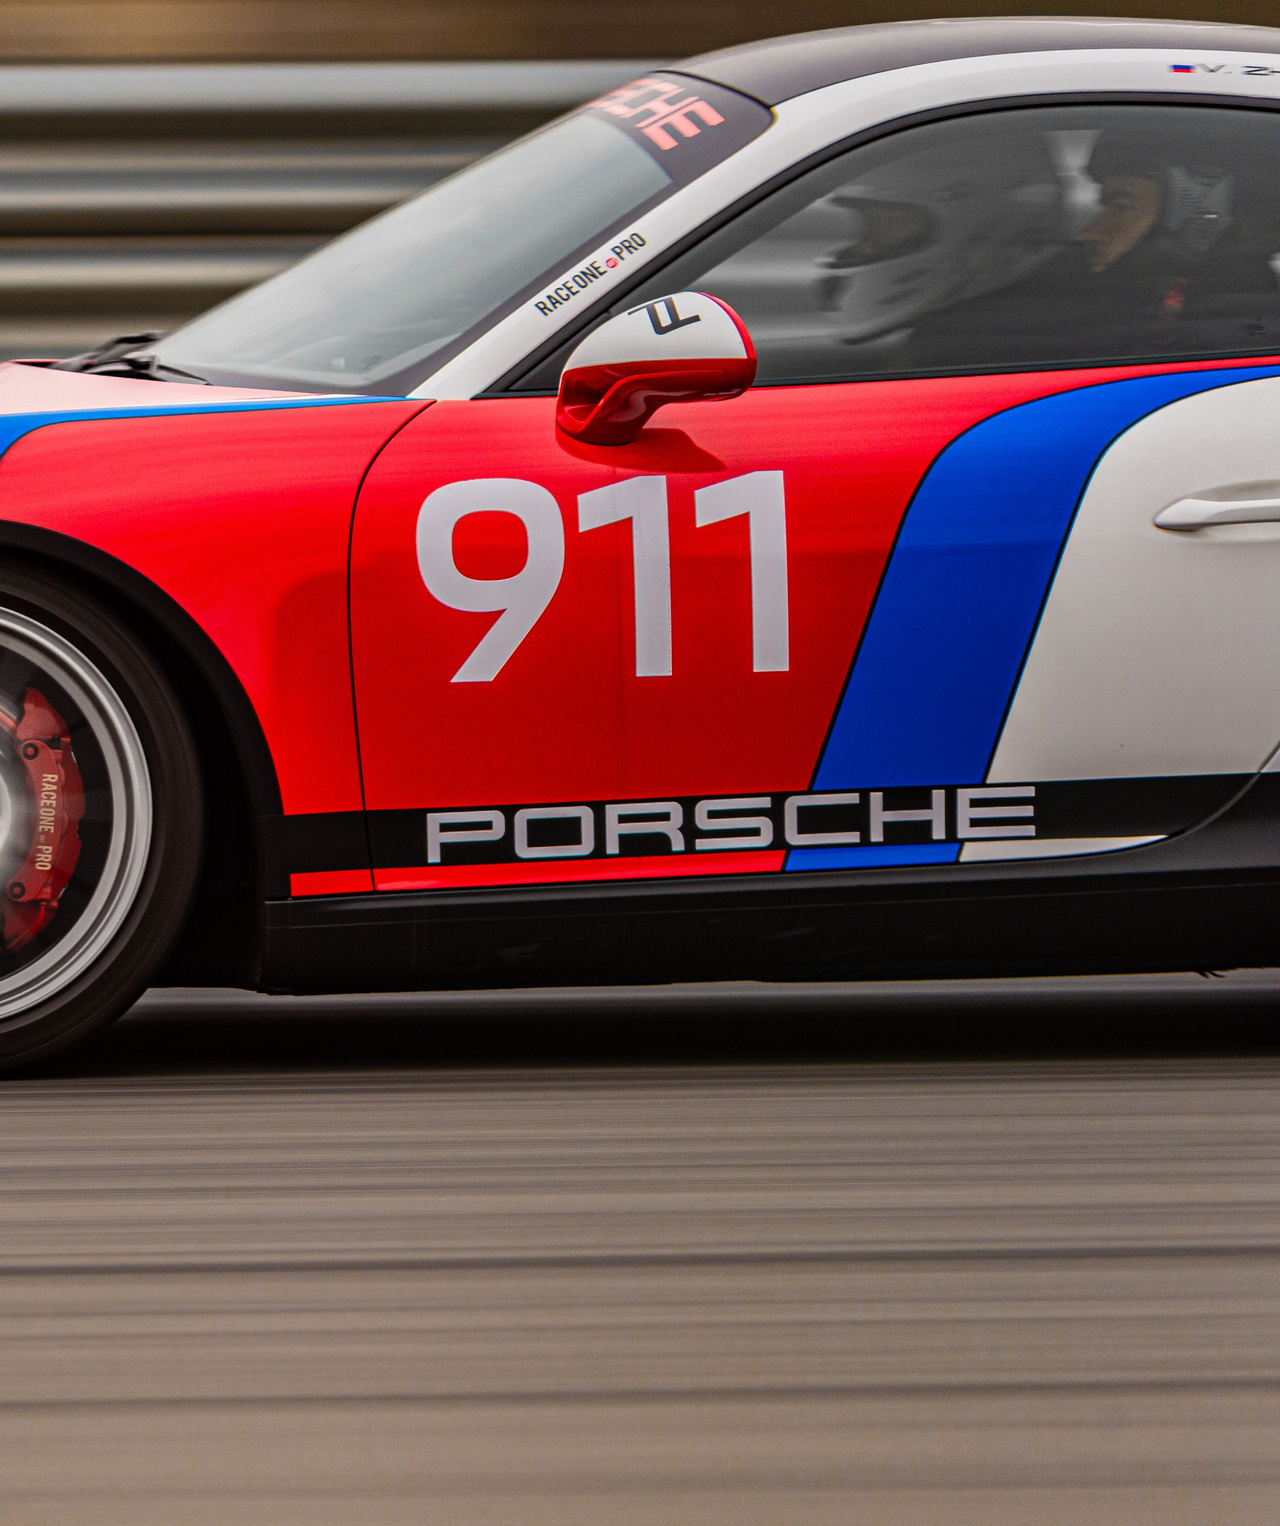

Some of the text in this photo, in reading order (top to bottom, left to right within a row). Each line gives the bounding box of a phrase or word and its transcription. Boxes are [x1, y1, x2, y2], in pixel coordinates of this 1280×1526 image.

[611, 232, 646, 260] PRO
[416, 470, 790, 682] 911
[426, 786, 1036, 863] PORSCHE
[35, 845, 52, 871] PRO
